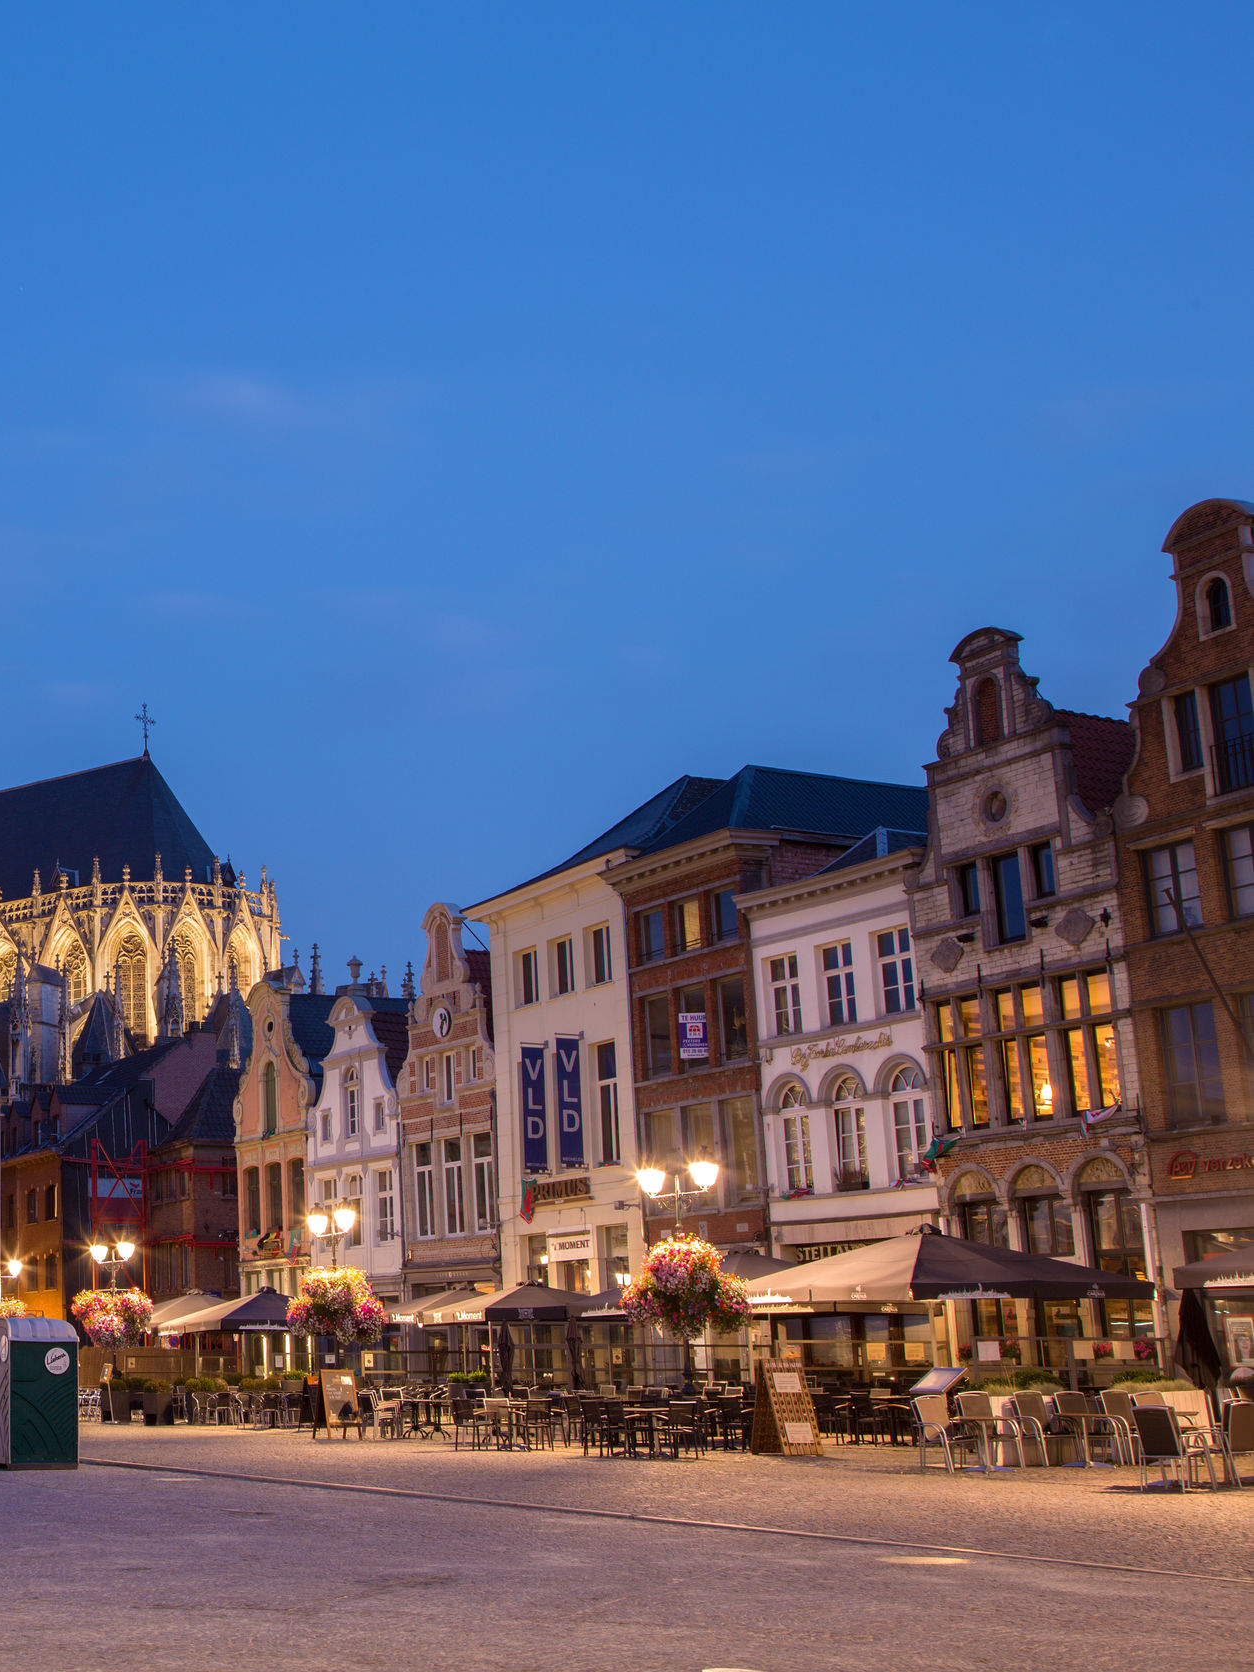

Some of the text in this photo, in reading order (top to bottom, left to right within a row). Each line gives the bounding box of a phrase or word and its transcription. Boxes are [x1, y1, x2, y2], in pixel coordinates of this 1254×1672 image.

[524, 1058, 545, 1138] VLD
[559, 1049, 580, 1132] VLD
[531, 1178, 588, 1203] PRIMUS
